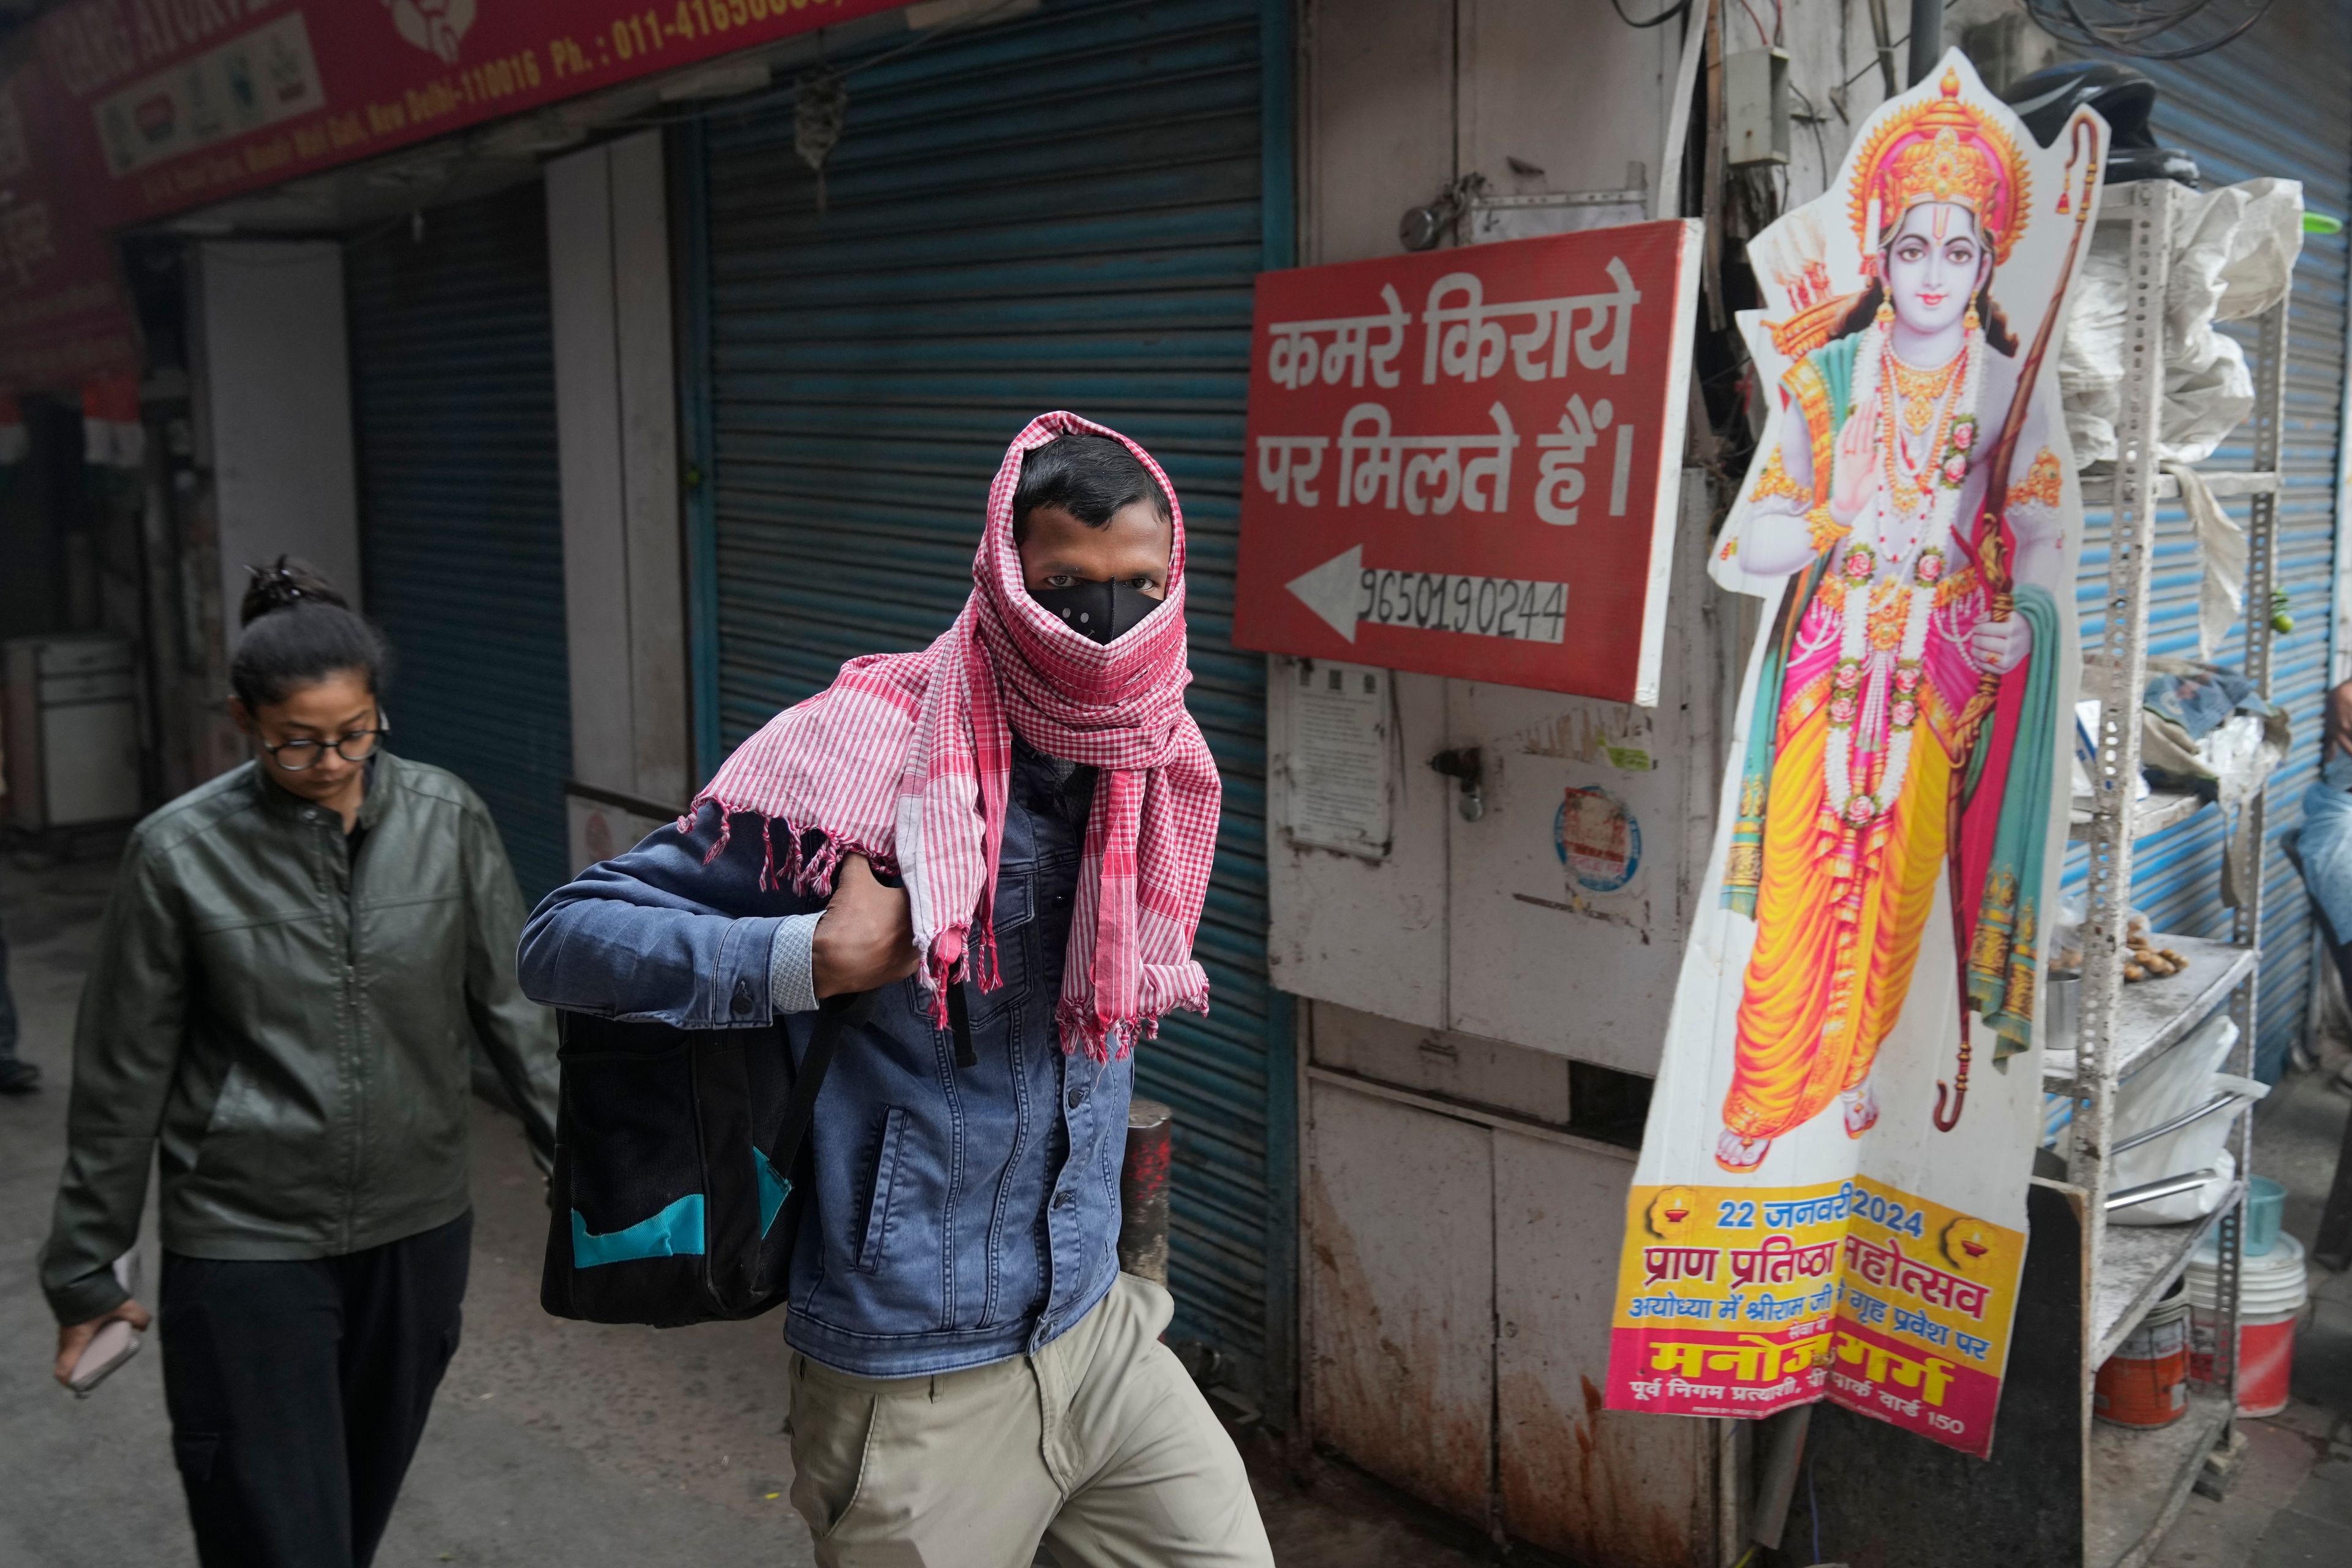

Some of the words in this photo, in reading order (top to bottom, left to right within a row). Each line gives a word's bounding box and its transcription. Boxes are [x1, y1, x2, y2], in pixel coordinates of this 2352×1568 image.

[1267, 283, 1411, 390] कमरे
[1422, 256, 1642, 385] किराये
[1257, 435, 1330, 508] पर
[1336, 401, 1520, 516] मिलते
[1356, 567, 1567, 641] 9650190244
[1717, 1200, 1755, 1227] 22
[1763, 1182, 1853, 1228] जनवरी
[1852, 1189, 1924, 1237] 2024
[1643, 1247, 1721, 1287] प्राण
[1728, 1235, 1839, 1290] प्रतिष्ठा
[1628, 1291, 1713, 1319] अयोध्या
[1717, 1292, 1744, 1320] में
[1746, 1293, 1805, 1321] श्रीराम
[1809, 1283, 1833, 1312] जी
[1849, 1288, 1888, 1324] गृह
[1893, 1309, 1950, 1346] प्रवेश
[1955, 1330, 1991, 1360] पर
[1629, 1377, 1663, 1401] पूर्व
[1666, 1378, 1725, 1400] निगम
[1877, 1389, 1924, 1418] वार्ड
[1928, 1411, 1966, 1434] 150
[1649, 1333, 1834, 1382] मनोज
[1837, 1330, 1956, 1407] गर्ग
